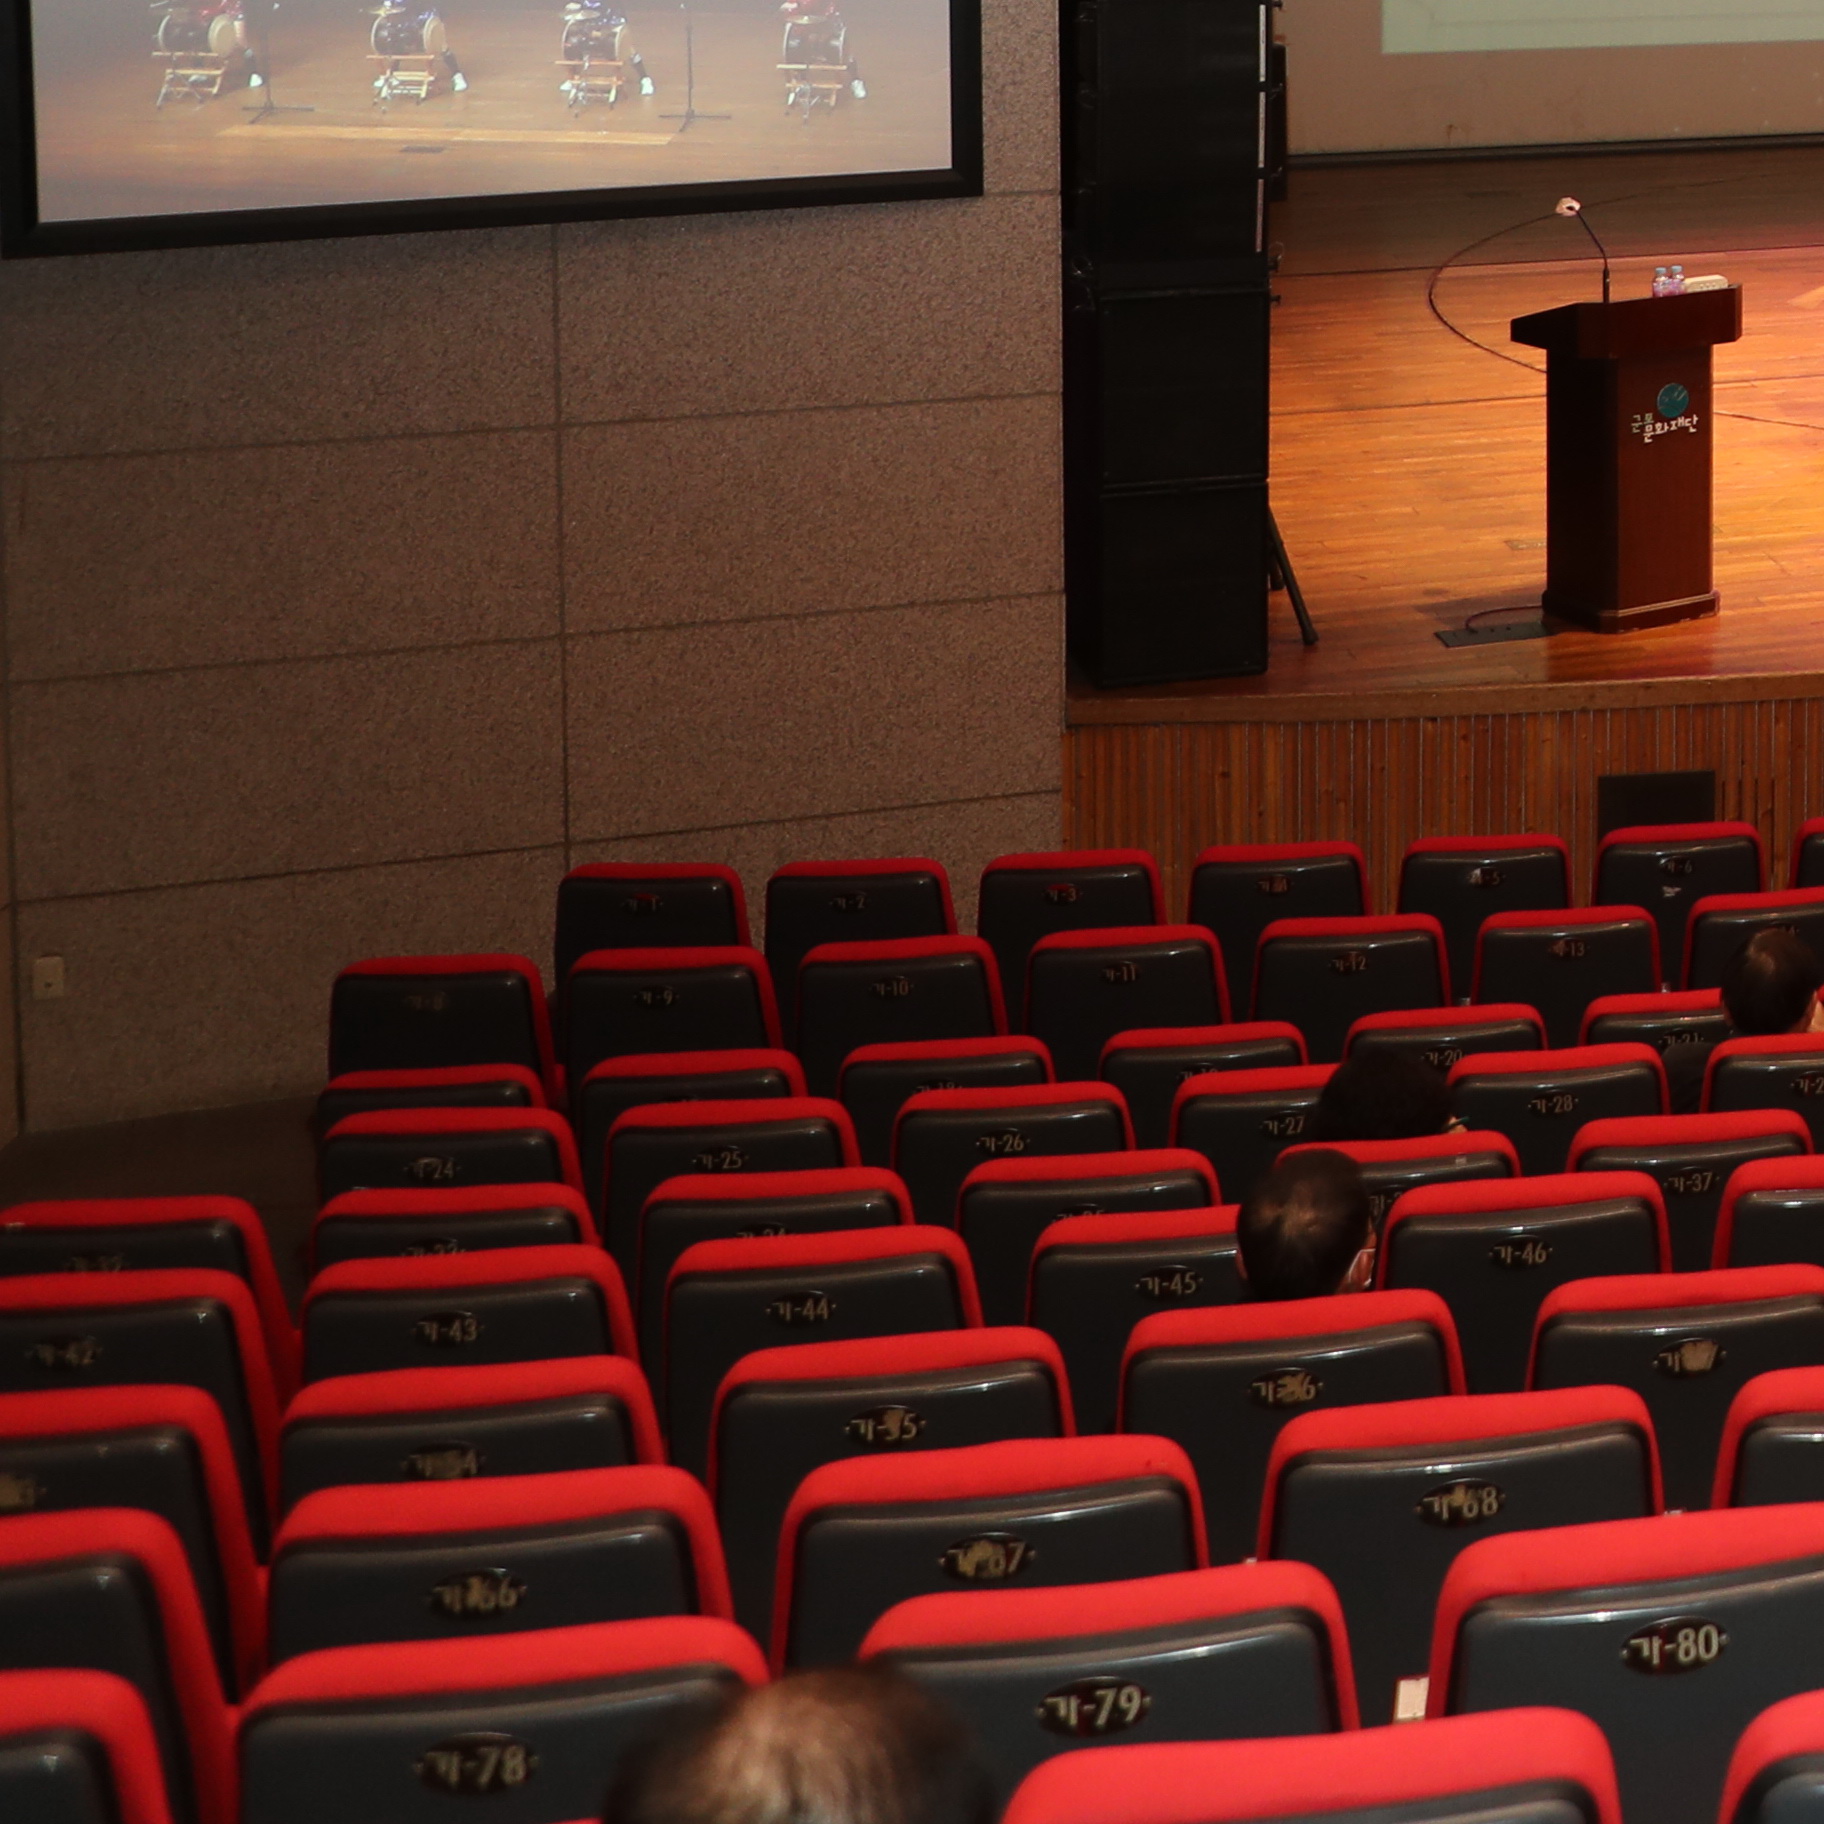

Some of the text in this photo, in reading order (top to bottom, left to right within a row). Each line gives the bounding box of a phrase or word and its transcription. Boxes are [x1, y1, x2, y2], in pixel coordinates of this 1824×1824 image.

[1631, 412, 1655, 434] 군포
[1643, 414, 1699, 444] 문화재단
[1533, 1095, 1573, 1112] 가-28
[981, 1135, 1024, 1153] 가-26
[700, 1153, 741, 1169] 가-25
[1670, 1175, 1712, 1192] 가-37
[1495, 1242, 1547, 1265] 가-46
[1141, 1273, 1197, 1296] 가-45
[773, 1298, 829, 1321] 가-44
[1629, 1625, 1719, 1668] 가-80
[1046, 1686, 1144, 1727] 가-79
[424, 1746, 529, 1789] 가-78
